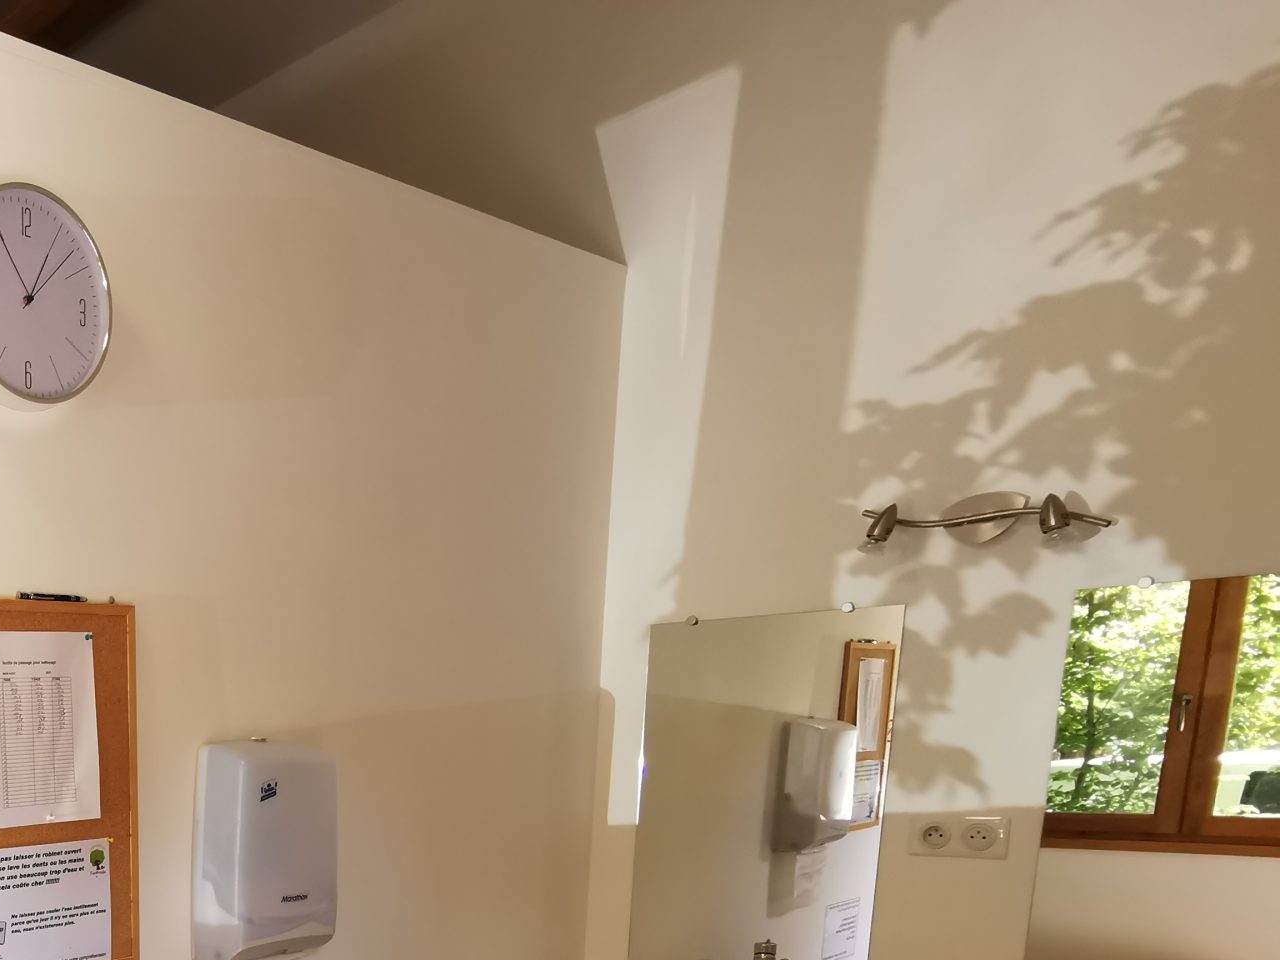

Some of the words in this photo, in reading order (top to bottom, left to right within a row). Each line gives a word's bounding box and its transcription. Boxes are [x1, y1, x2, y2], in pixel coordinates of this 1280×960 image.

[21, 206, 32, 238] 12
[80, 298, 86, 327] 3
[24, 361, 32, 389] 6
[42, 850, 63, 858] robinet
